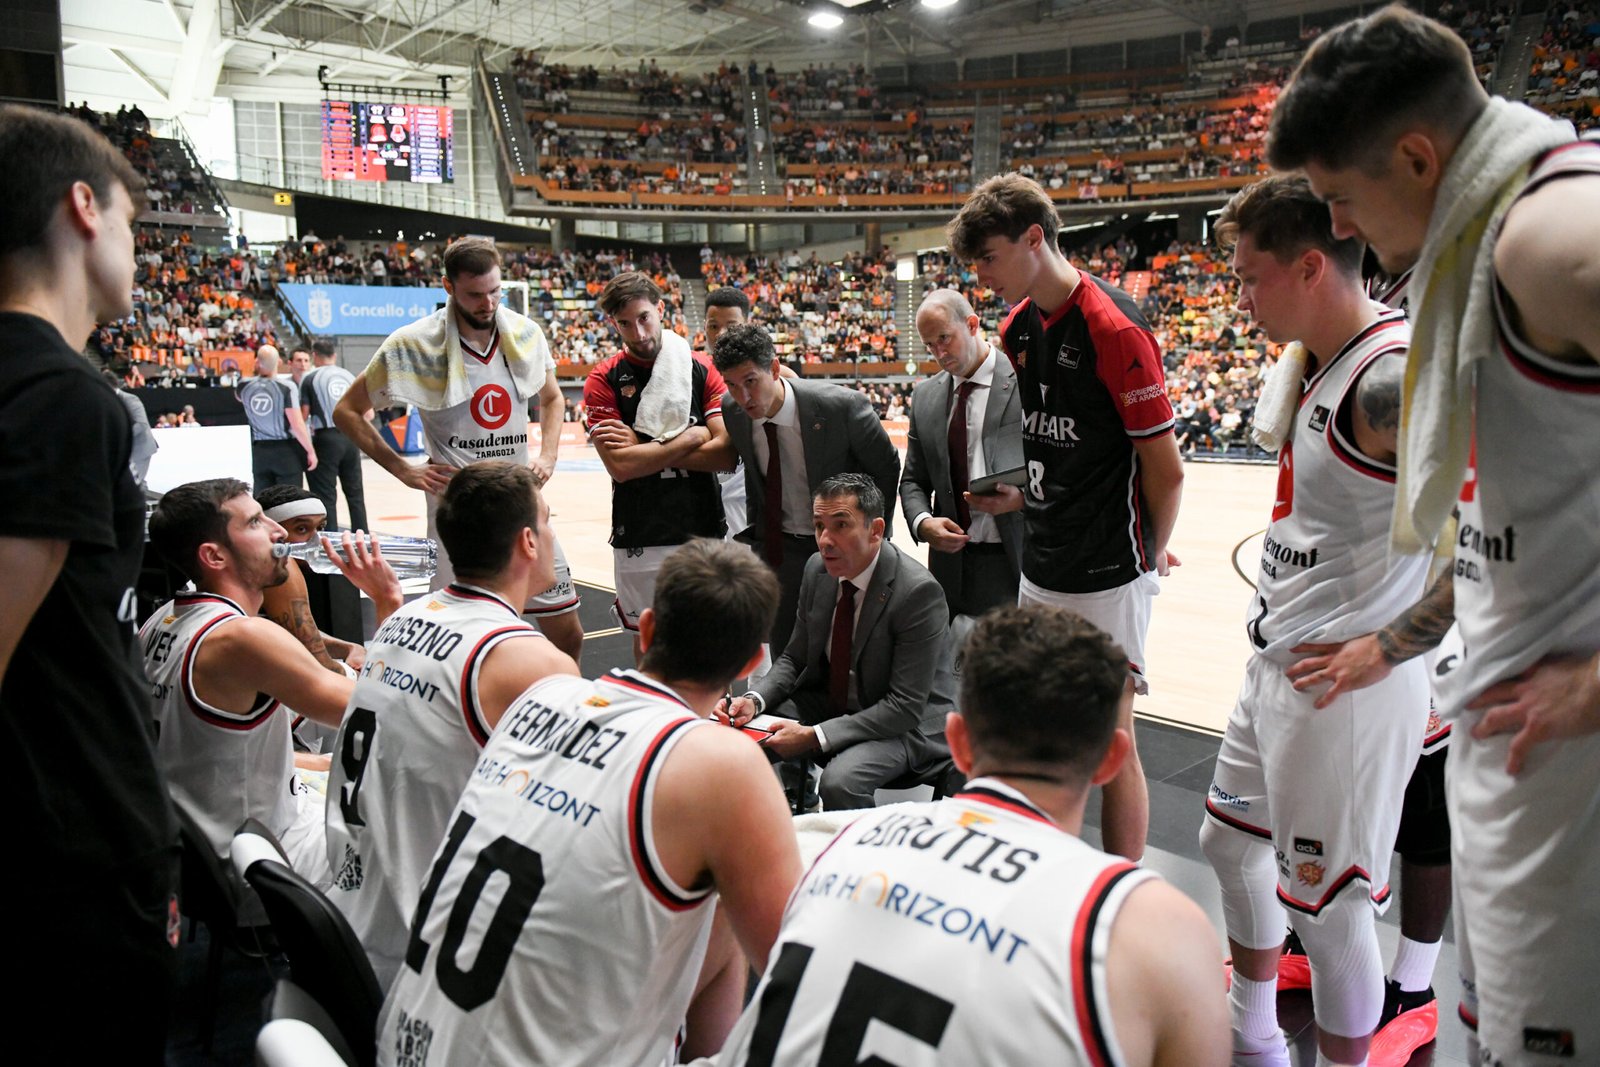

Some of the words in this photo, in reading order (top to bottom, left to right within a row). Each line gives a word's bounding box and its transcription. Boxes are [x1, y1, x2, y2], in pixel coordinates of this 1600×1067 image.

[340, 303, 405, 317] Concello
[408, 303, 427, 317] da
[1127, 383, 1160, 398] GOBIERNO
[254, 398, 269, 411] 77
[448, 432, 528, 449] Casademon
[475, 447, 516, 459] ZARAGOZA
[1264, 536, 1320, 569] emont
[362, 660, 441, 703] HORIZONT
[1296, 844, 1317, 854] acb
[405, 809, 547, 1014] 10
[836, 869, 1030, 964] HORIZONT
